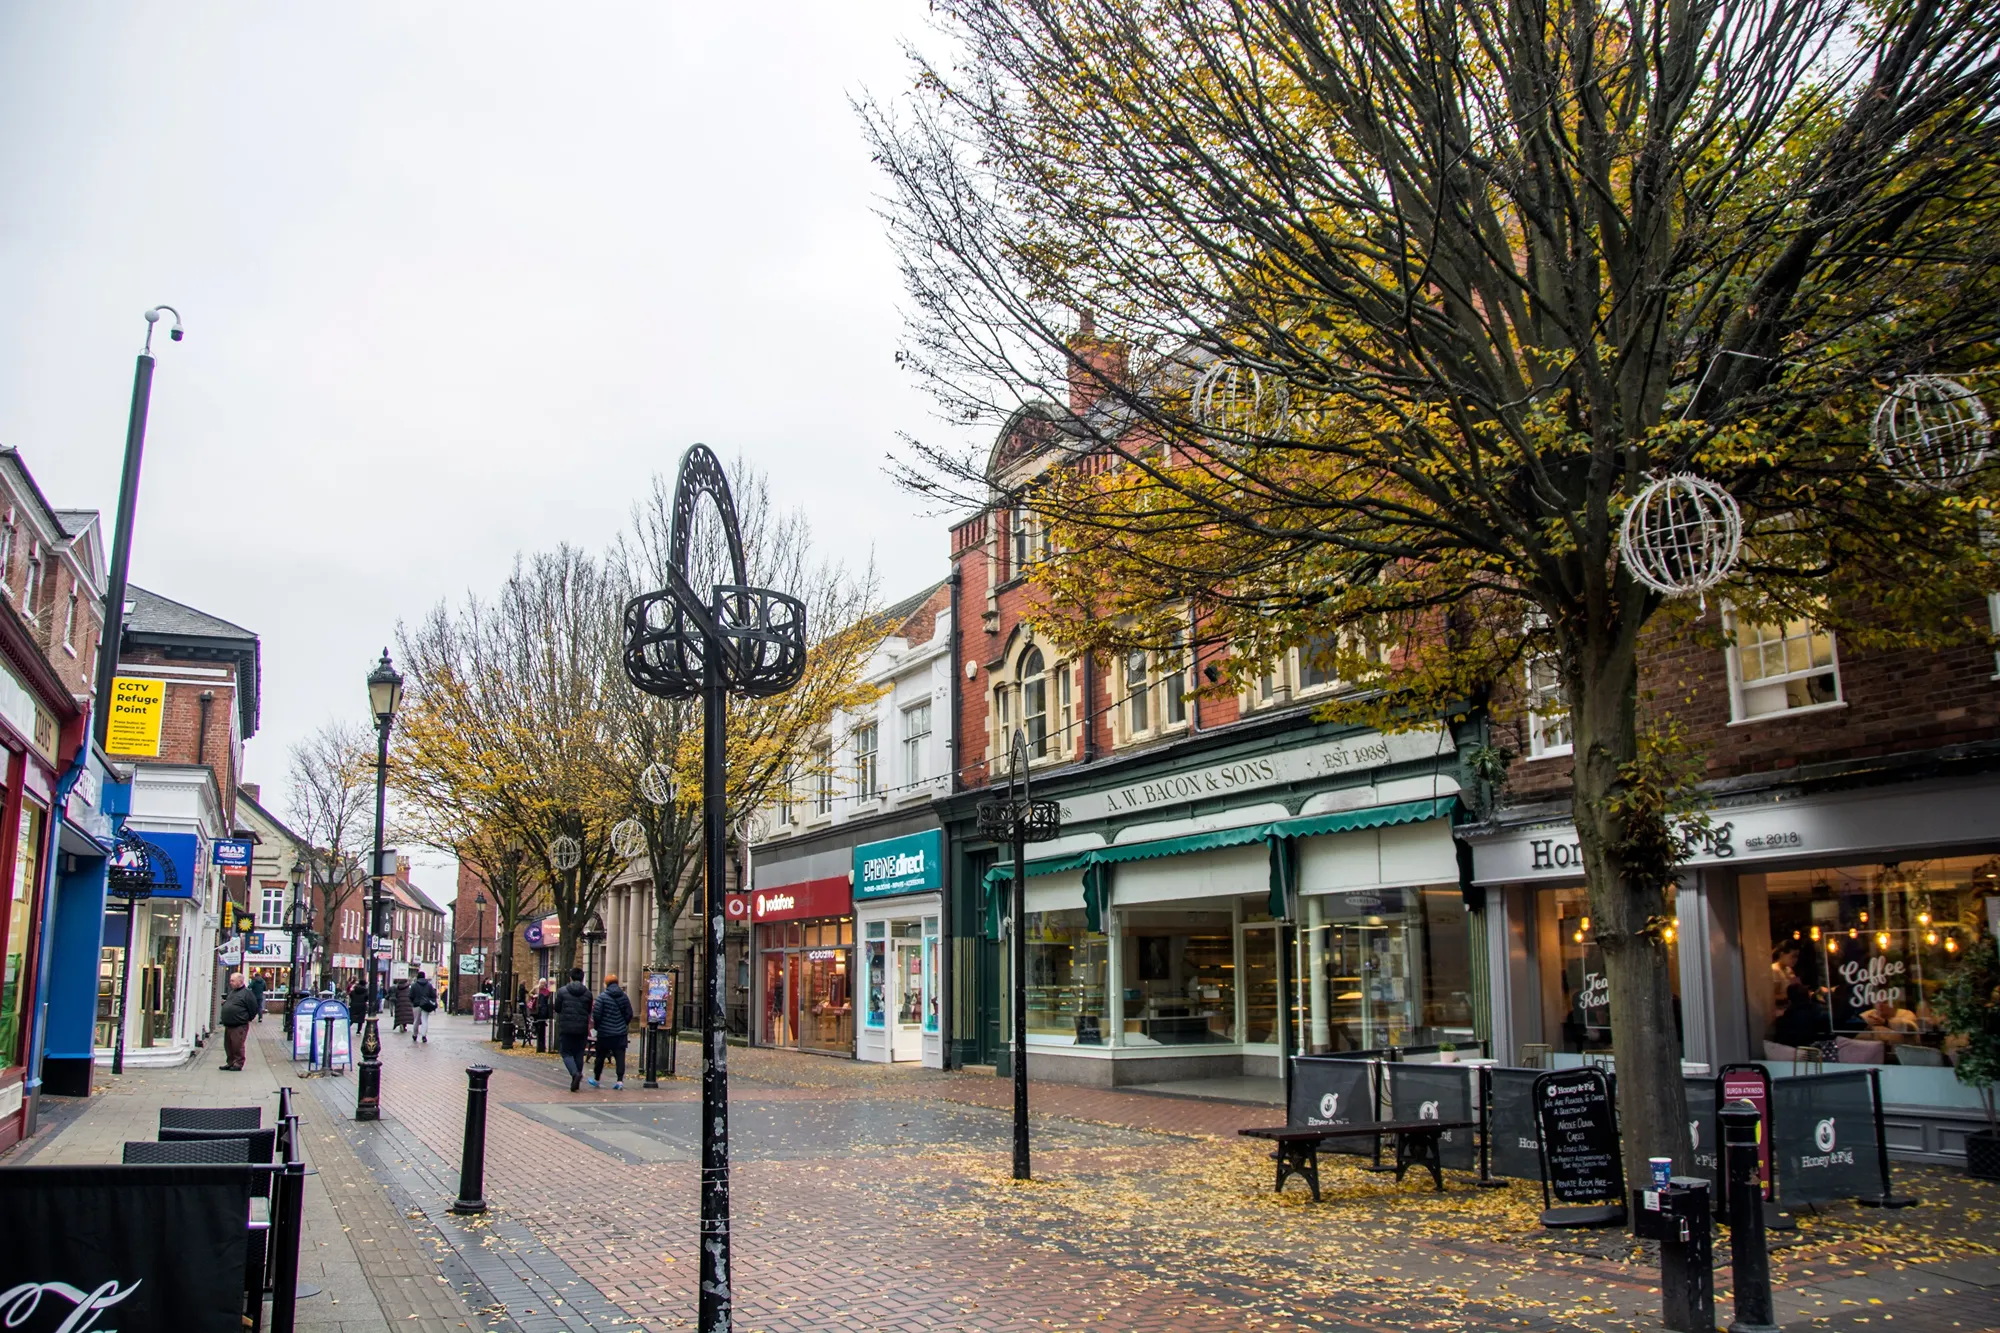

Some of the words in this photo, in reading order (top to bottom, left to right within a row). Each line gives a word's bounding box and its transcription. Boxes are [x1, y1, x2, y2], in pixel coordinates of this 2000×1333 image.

[118, 682, 149, 692] CCTV
[117, 694, 158, 704] Refuge
[116, 705, 147, 714] Point
[1352, 744, 1387, 763] 1938
[1108, 794, 1122, 811] A.
[1122, 788, 1142, 807] W.
[1143, 775, 1202, 803] BACON
[1205, 772, 1220, 791] &
[1221, 759, 1274, 788] SONS
[219, 846, 245, 854] MAX
[766, 894, 794, 912] vodafone
[1839, 955, 1906, 986] Coffee
[1849, 983, 1900, 1008] Shop
[1557, 1086, 1578, 1094] Honey
[1584, 1083, 1595, 1091] Fig
[1801, 1156, 1829, 1168] Honey
[1830, 1152, 1837, 1164] &
[1837, 1151, 1854, 1164] Fig
[1578, 1178, 1593, 1187] ROOM
